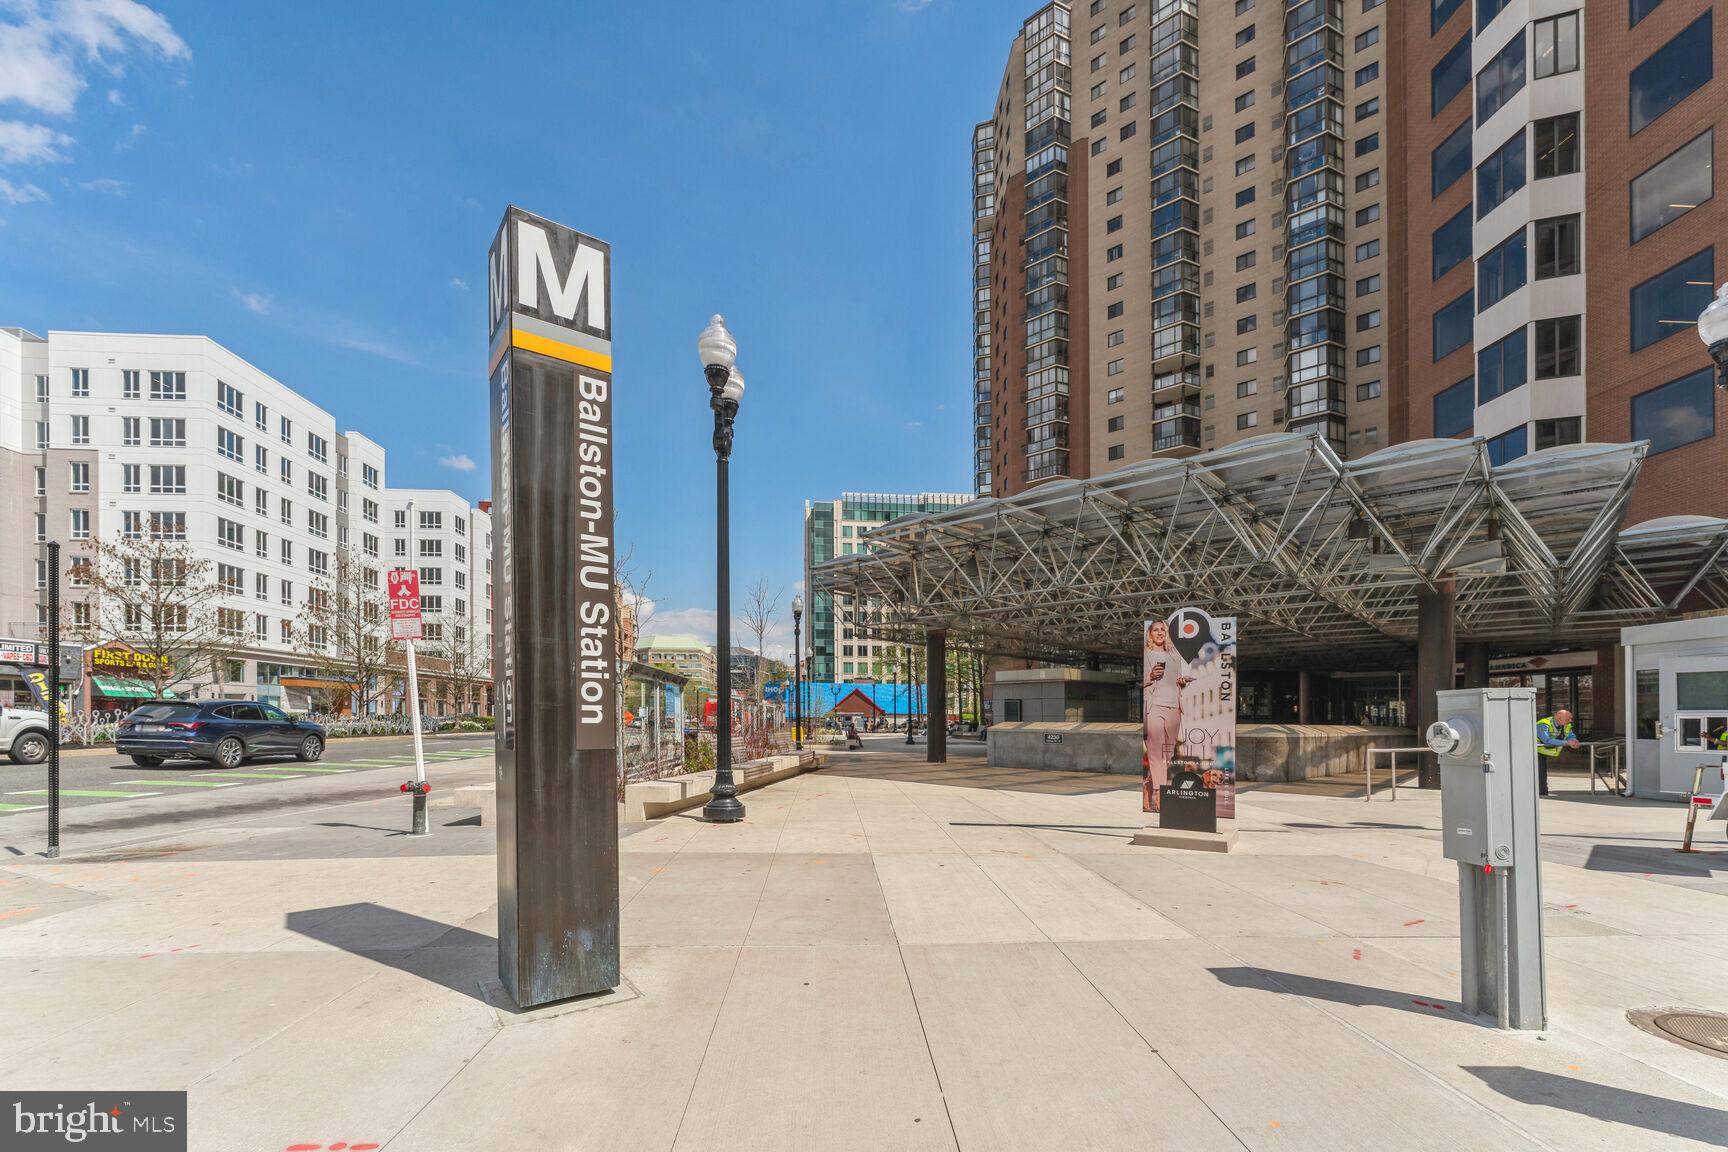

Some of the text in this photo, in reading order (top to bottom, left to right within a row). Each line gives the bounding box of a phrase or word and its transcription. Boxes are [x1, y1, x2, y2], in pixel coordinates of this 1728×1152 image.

[489, 220, 508, 337] M
[517, 220, 605, 330] M
[578, 374, 610, 724] Ballston-MU Station
[390, 598, 420, 610] FDC
[94, 649, 130, 660] FIRST
[94, 658, 124, 667] SPORTS
[1221, 622, 1232, 702] BALLSTON
[765, 686, 784, 694] IHOP
[1166, 789, 1210, 798] ARLINGTON
